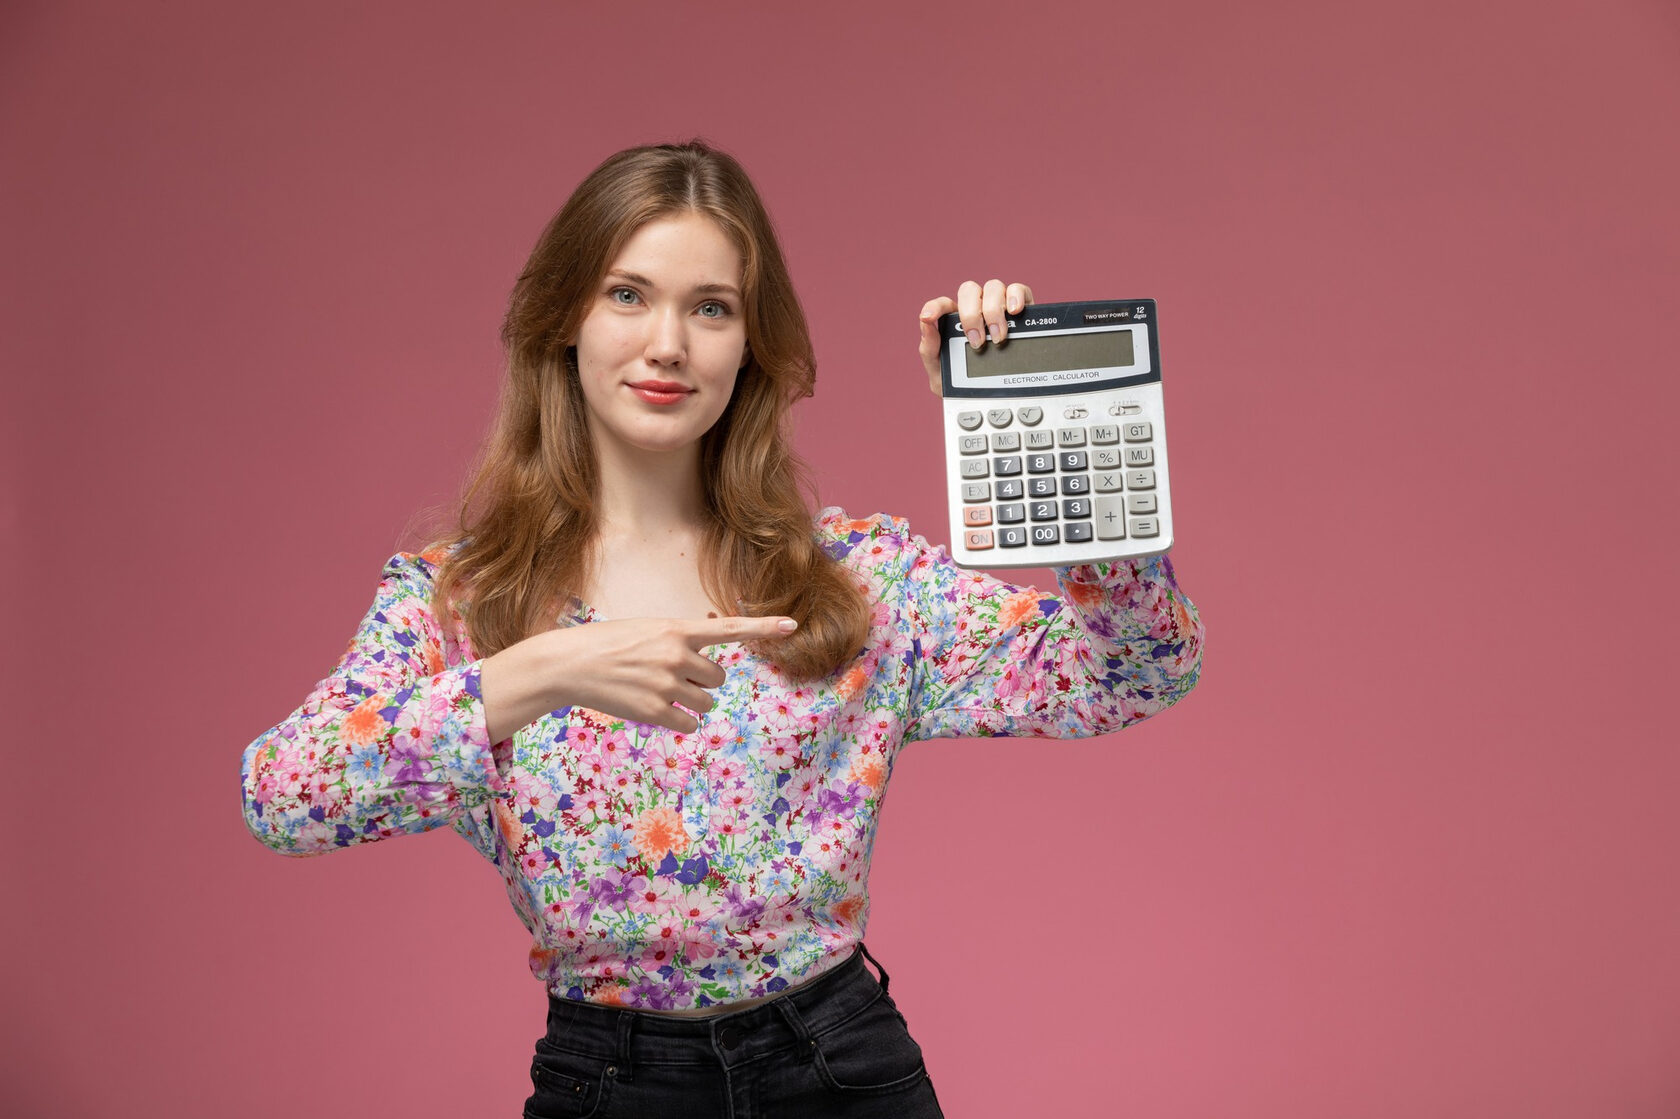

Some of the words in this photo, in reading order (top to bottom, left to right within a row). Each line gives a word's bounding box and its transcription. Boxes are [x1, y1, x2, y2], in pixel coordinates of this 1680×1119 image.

[1136, 306, 1145, 314] 12
[1025, 317, 1057, 326] CA-2800
[1003, 375, 1048, 384] ELECTRONIC
[1052, 372, 1100, 381] CALCULATOR
[1096, 429, 1113, 439] M+
[1130, 426, 1145, 436] GT
[998, 436, 1014, 445] MC
[1031, 435, 1047, 443] MR
[1063, 432, 1078, 441] M-
[965, 438, 982, 448] OFF
[1068, 455, 1078, 465] 9
[1100, 453, 1113, 463] %
[1131, 451, 1148, 460] MU
[969, 463, 982, 472] AC
[1002, 460, 1012, 470] 7
[1035, 458, 1045, 468] 8
[1003, 483, 1013, 494] 4
[1037, 481, 1046, 492] 5
[1070, 479, 1079, 489] 6
[968, 486, 984, 496] EX
[1006, 507, 1013, 517] 1
[1038, 505, 1047, 516] 2
[1071, 502, 1081, 513] 3
[970, 510, 986, 520] CE
[1007, 531, 1016, 542] 0
[1036, 528, 1054, 539] 00
[971, 535, 989, 544] ON
